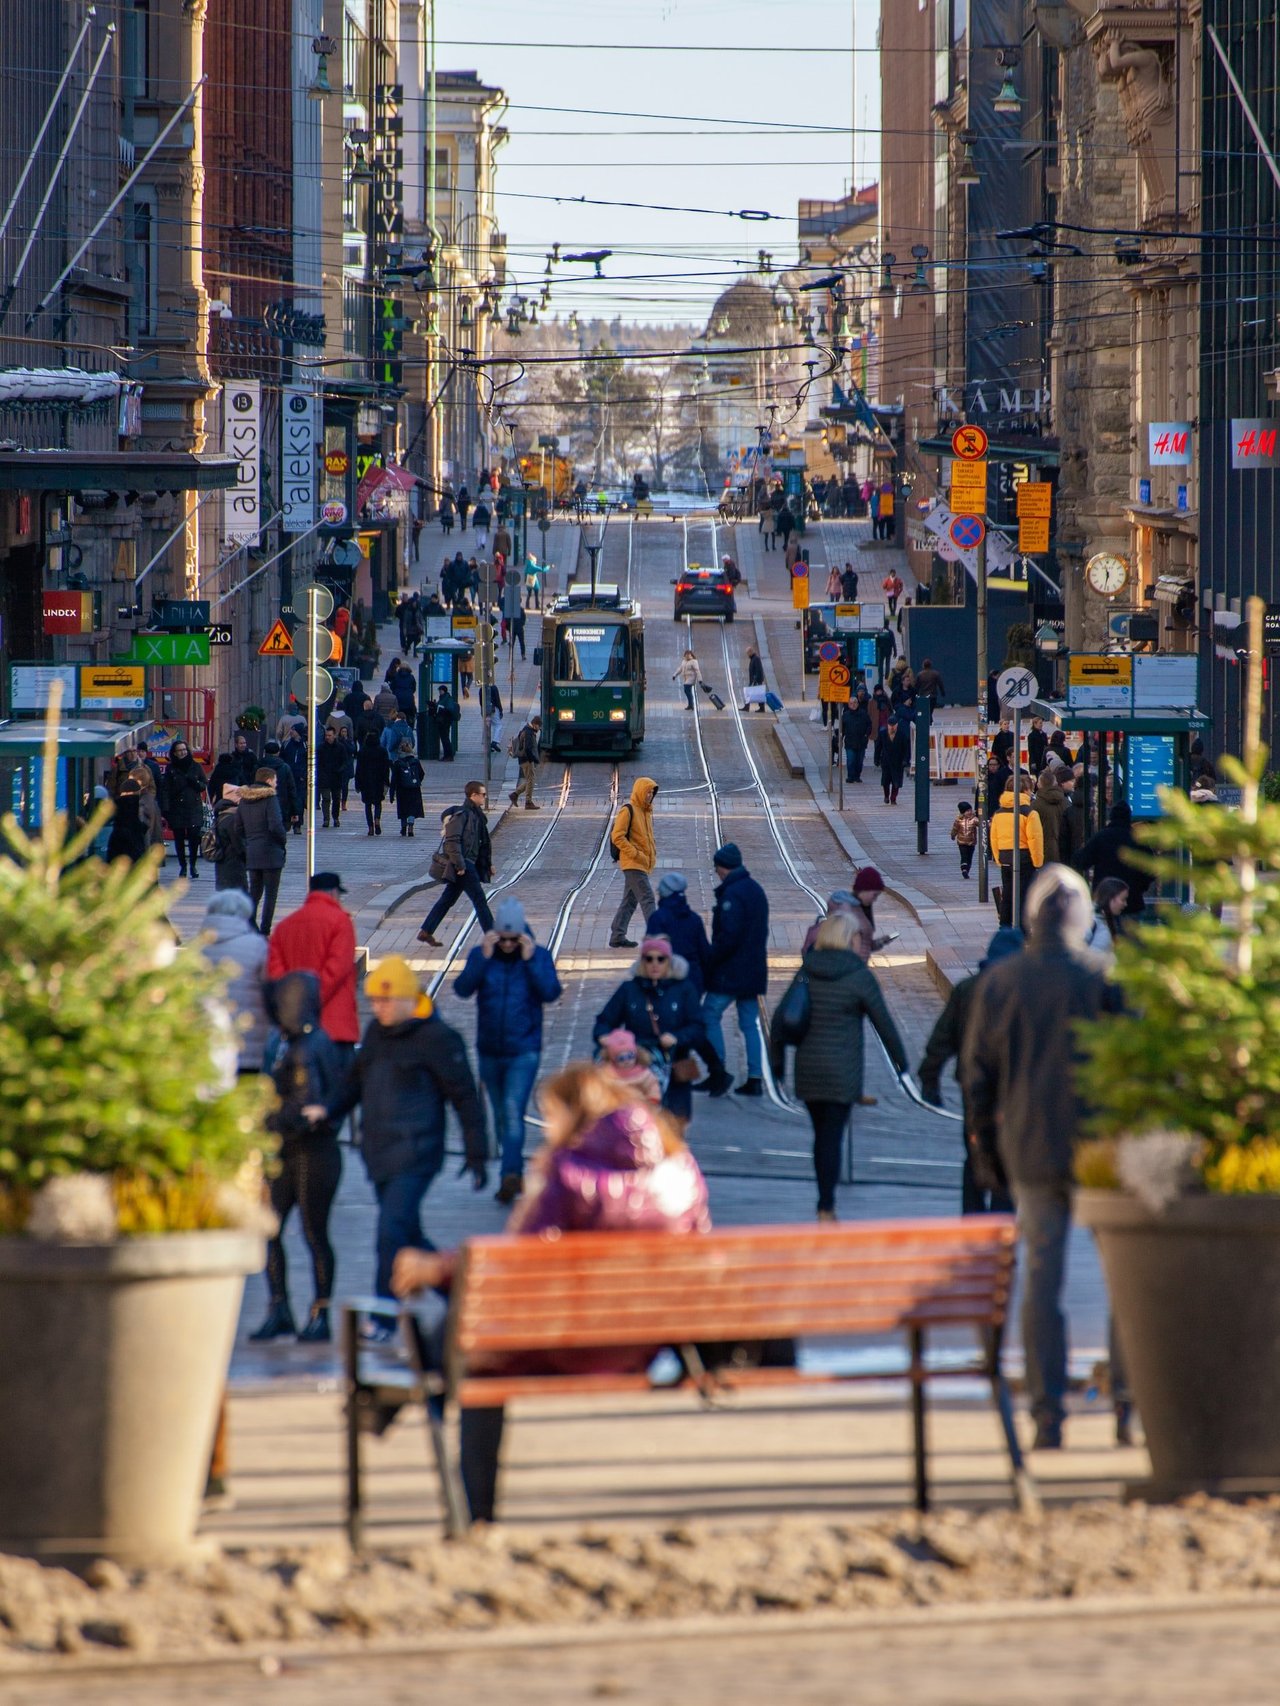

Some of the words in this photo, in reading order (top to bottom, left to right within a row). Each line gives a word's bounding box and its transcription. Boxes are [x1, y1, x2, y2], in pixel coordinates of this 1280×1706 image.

[236, 396, 248, 408] 13
[293, 399, 303, 410] 13
[1154, 431, 1188, 456] H&M
[1237, 428, 1278, 458] H&M
[226, 418, 256, 514] aleksi
[284, 418, 310, 503] aleksi
[325, 457, 348, 467] RAX
[42, 609, 77, 617] LINDEX
[565, 629, 573, 642] 4
[1006, 677, 1030, 697] 20
[592, 711, 604, 719] 90
